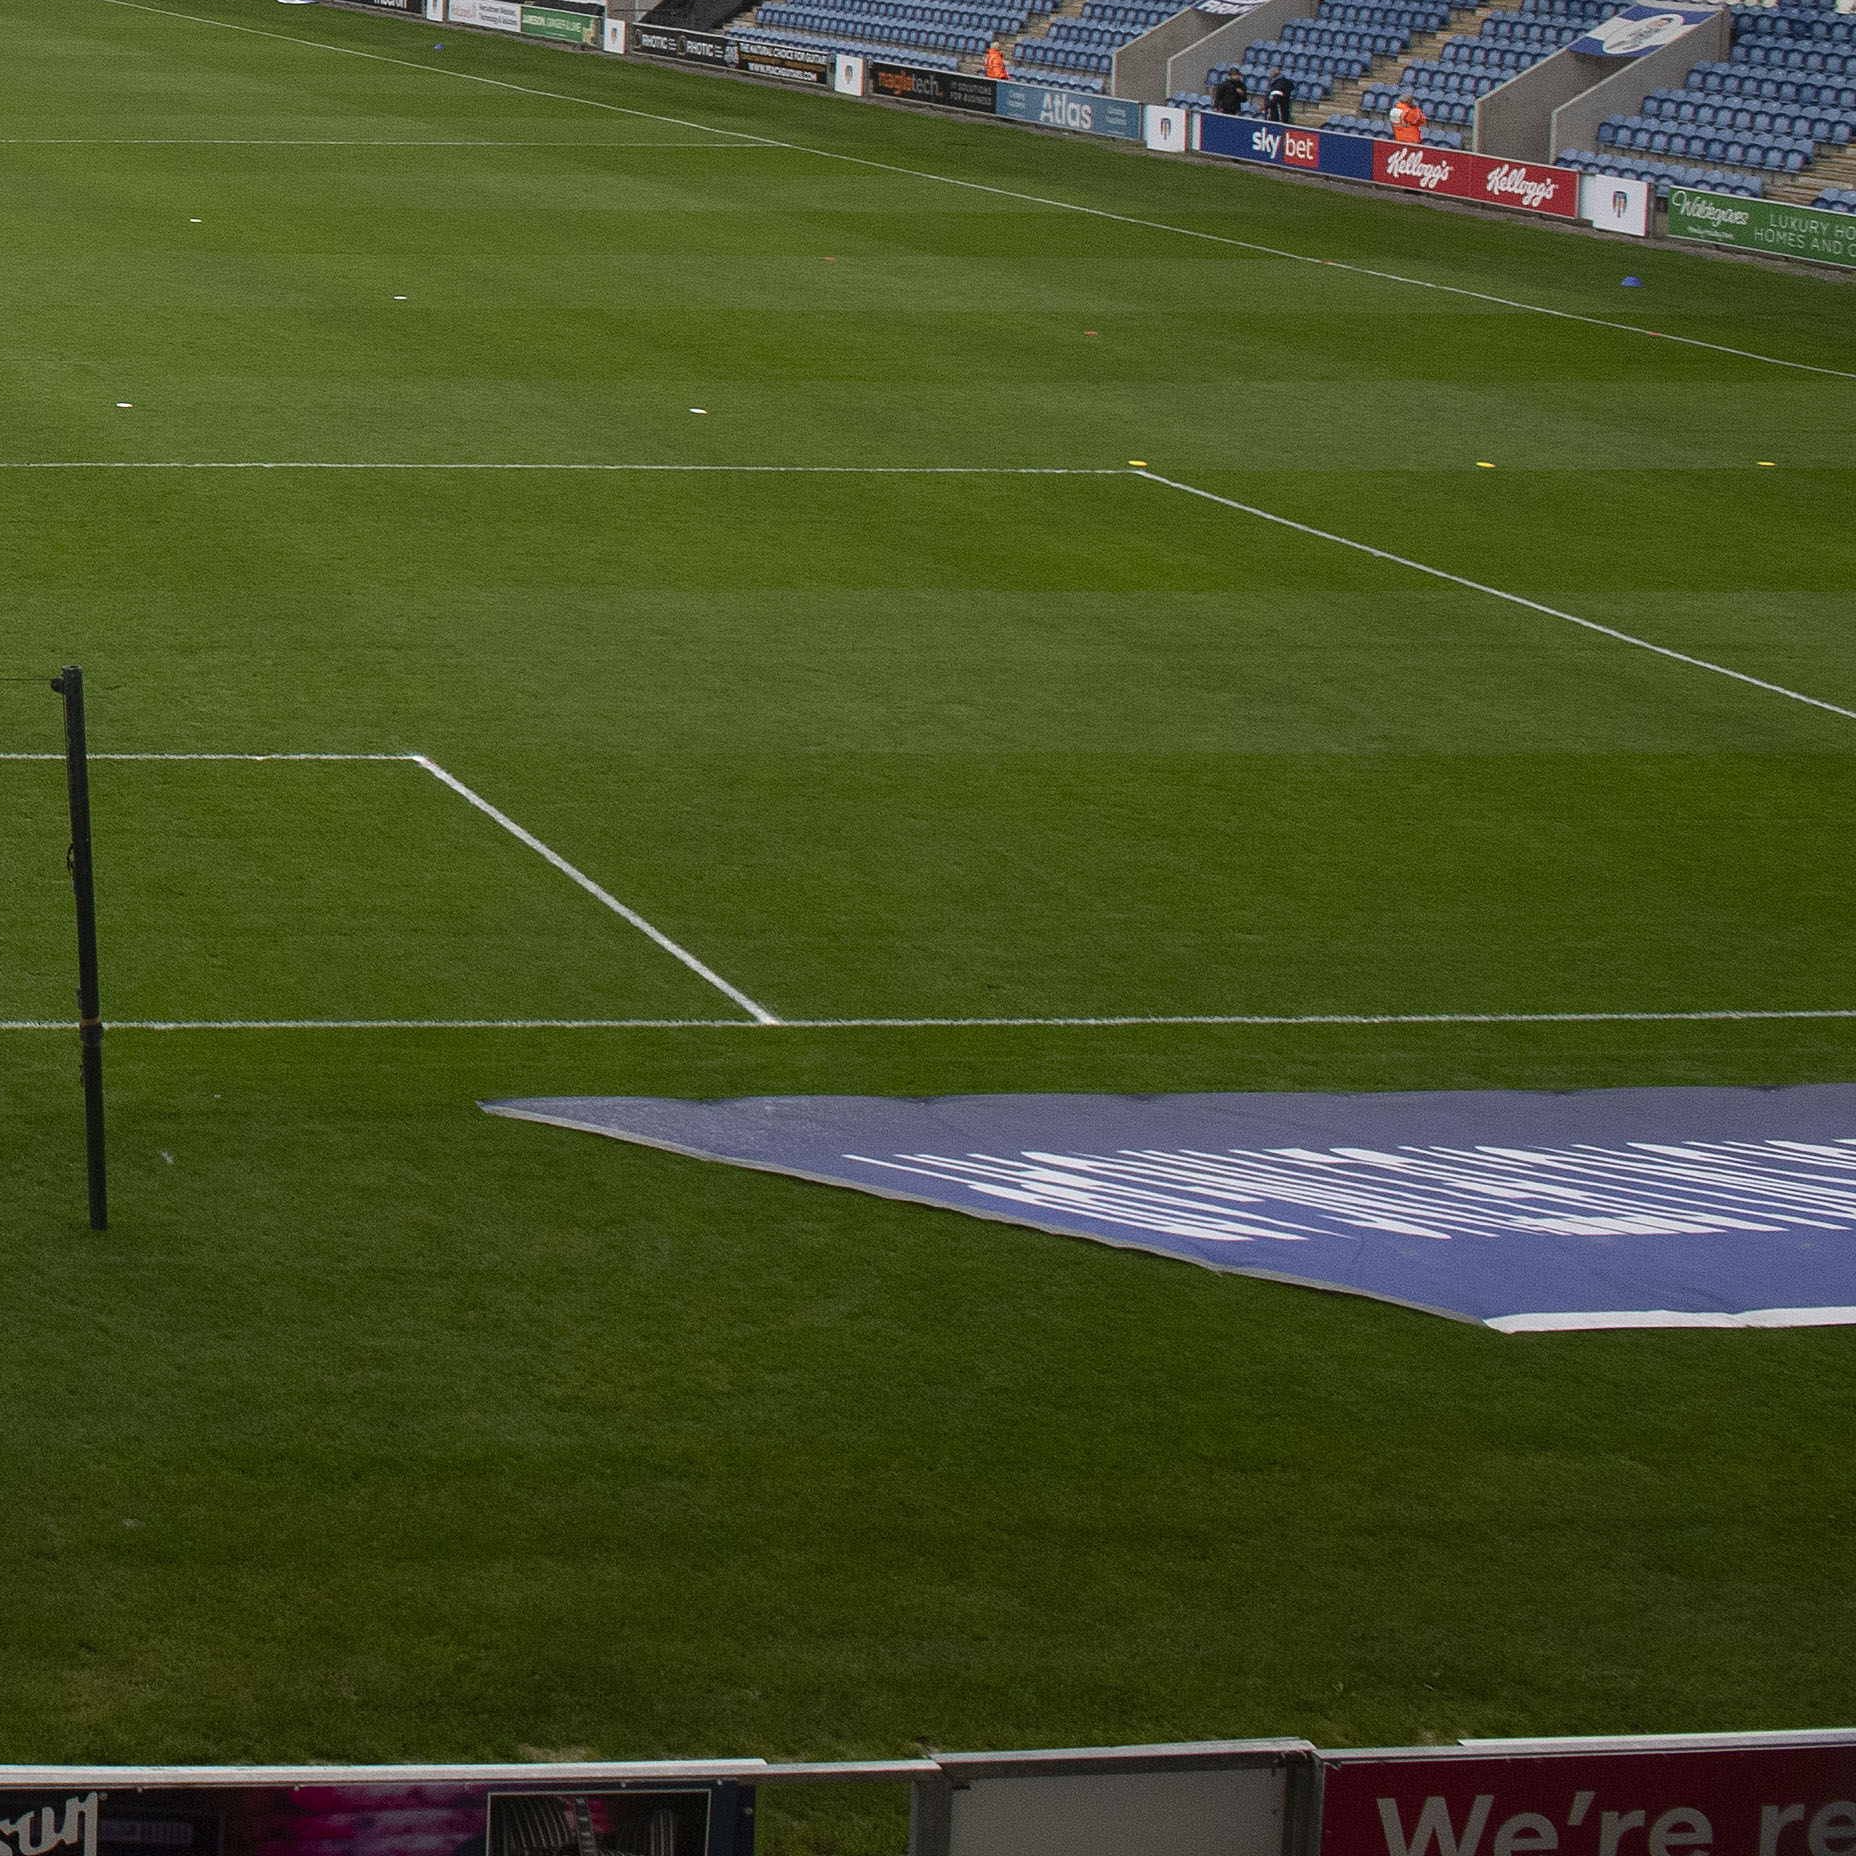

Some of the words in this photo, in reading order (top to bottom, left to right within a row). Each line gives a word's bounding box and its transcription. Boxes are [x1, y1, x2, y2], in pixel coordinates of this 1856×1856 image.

[1039, 93, 1093, 129] Atlas
[1251, 127, 1282, 158] sky
[1285, 133, 1314, 161] bet
[1388, 147, 1453, 189] Kellogg's
[1487, 164, 1559, 207] Kellogg's
[1769, 214, 1829, 235] LUXURY
[1754, 227, 1806, 249] HOMES
[1810, 238, 1843, 255] AND
